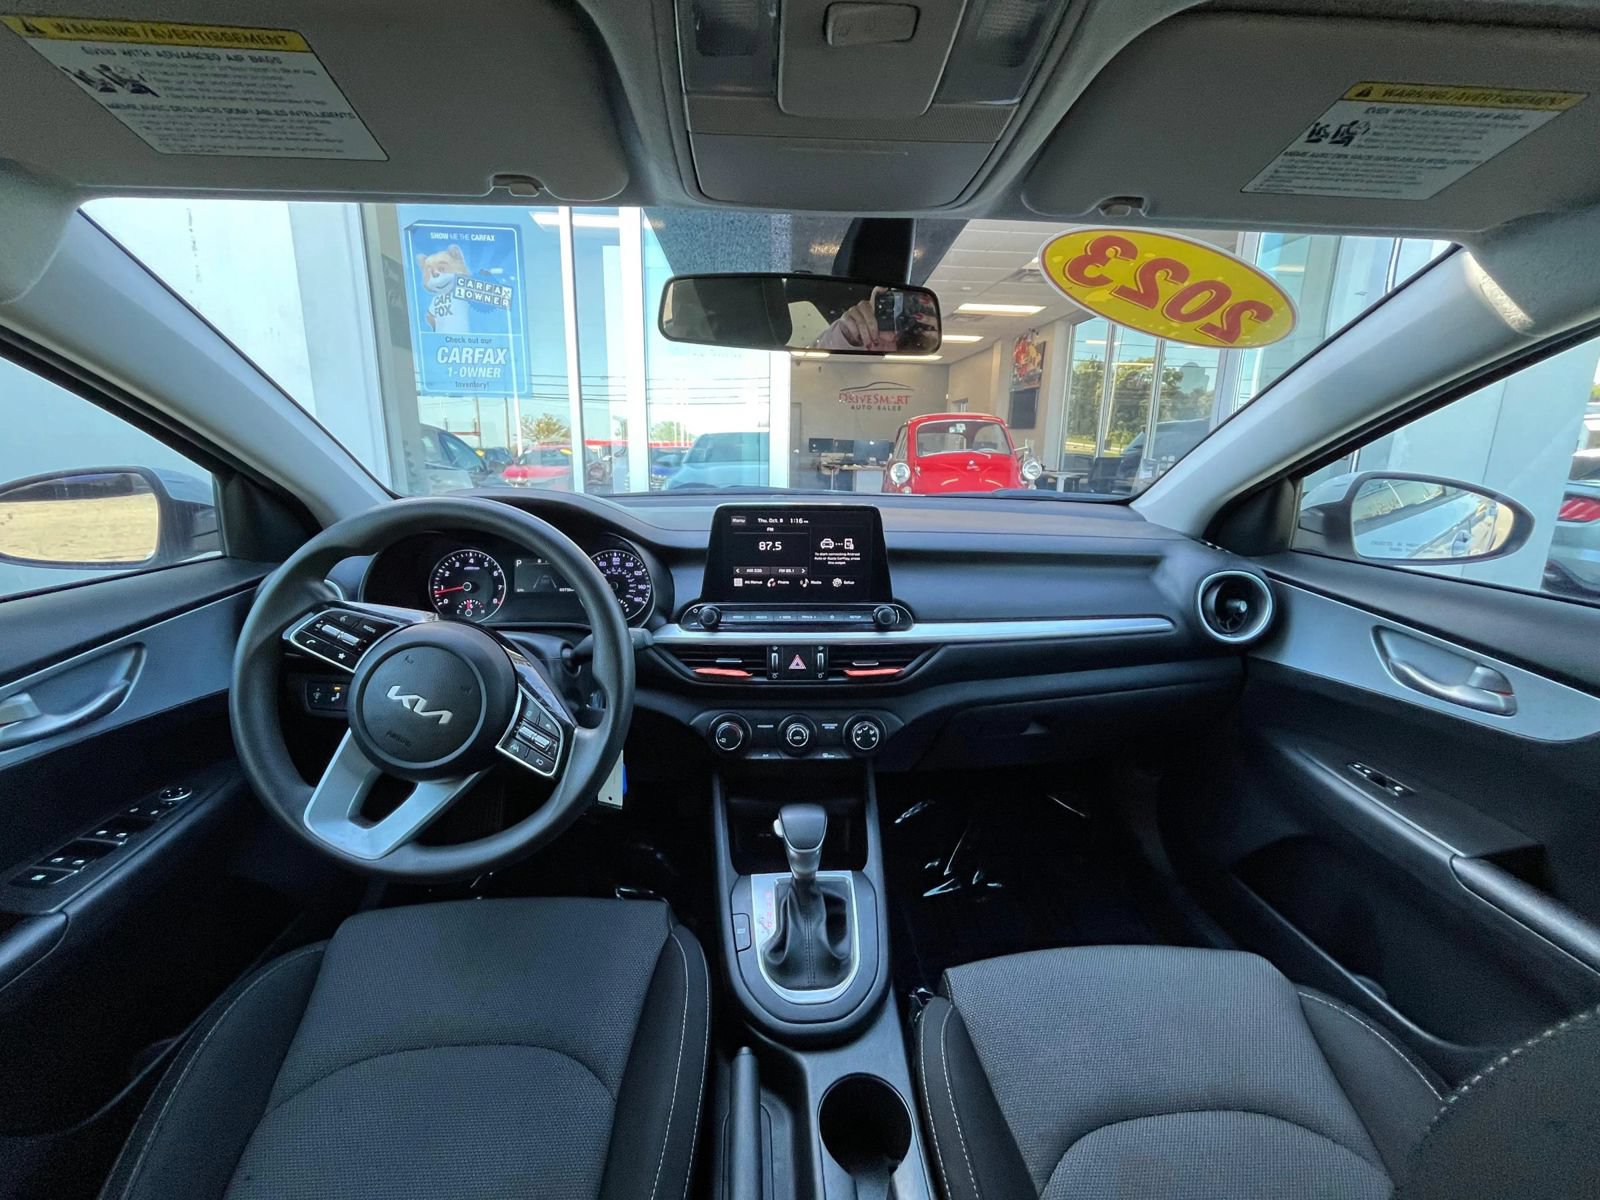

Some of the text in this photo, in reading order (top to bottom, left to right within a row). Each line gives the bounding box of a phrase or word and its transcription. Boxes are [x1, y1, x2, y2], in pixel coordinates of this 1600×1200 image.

[430, 232, 449, 240] SHOW
[471, 234, 495, 242] CARFAX
[434, 304, 454, 317] FOX
[445, 335, 466, 344] Check
[437, 346, 508, 365] CARFAX
[758, 541, 782, 551] 87.5
[516, 559, 522, 567] P
[386, 685, 453, 724] KIA
